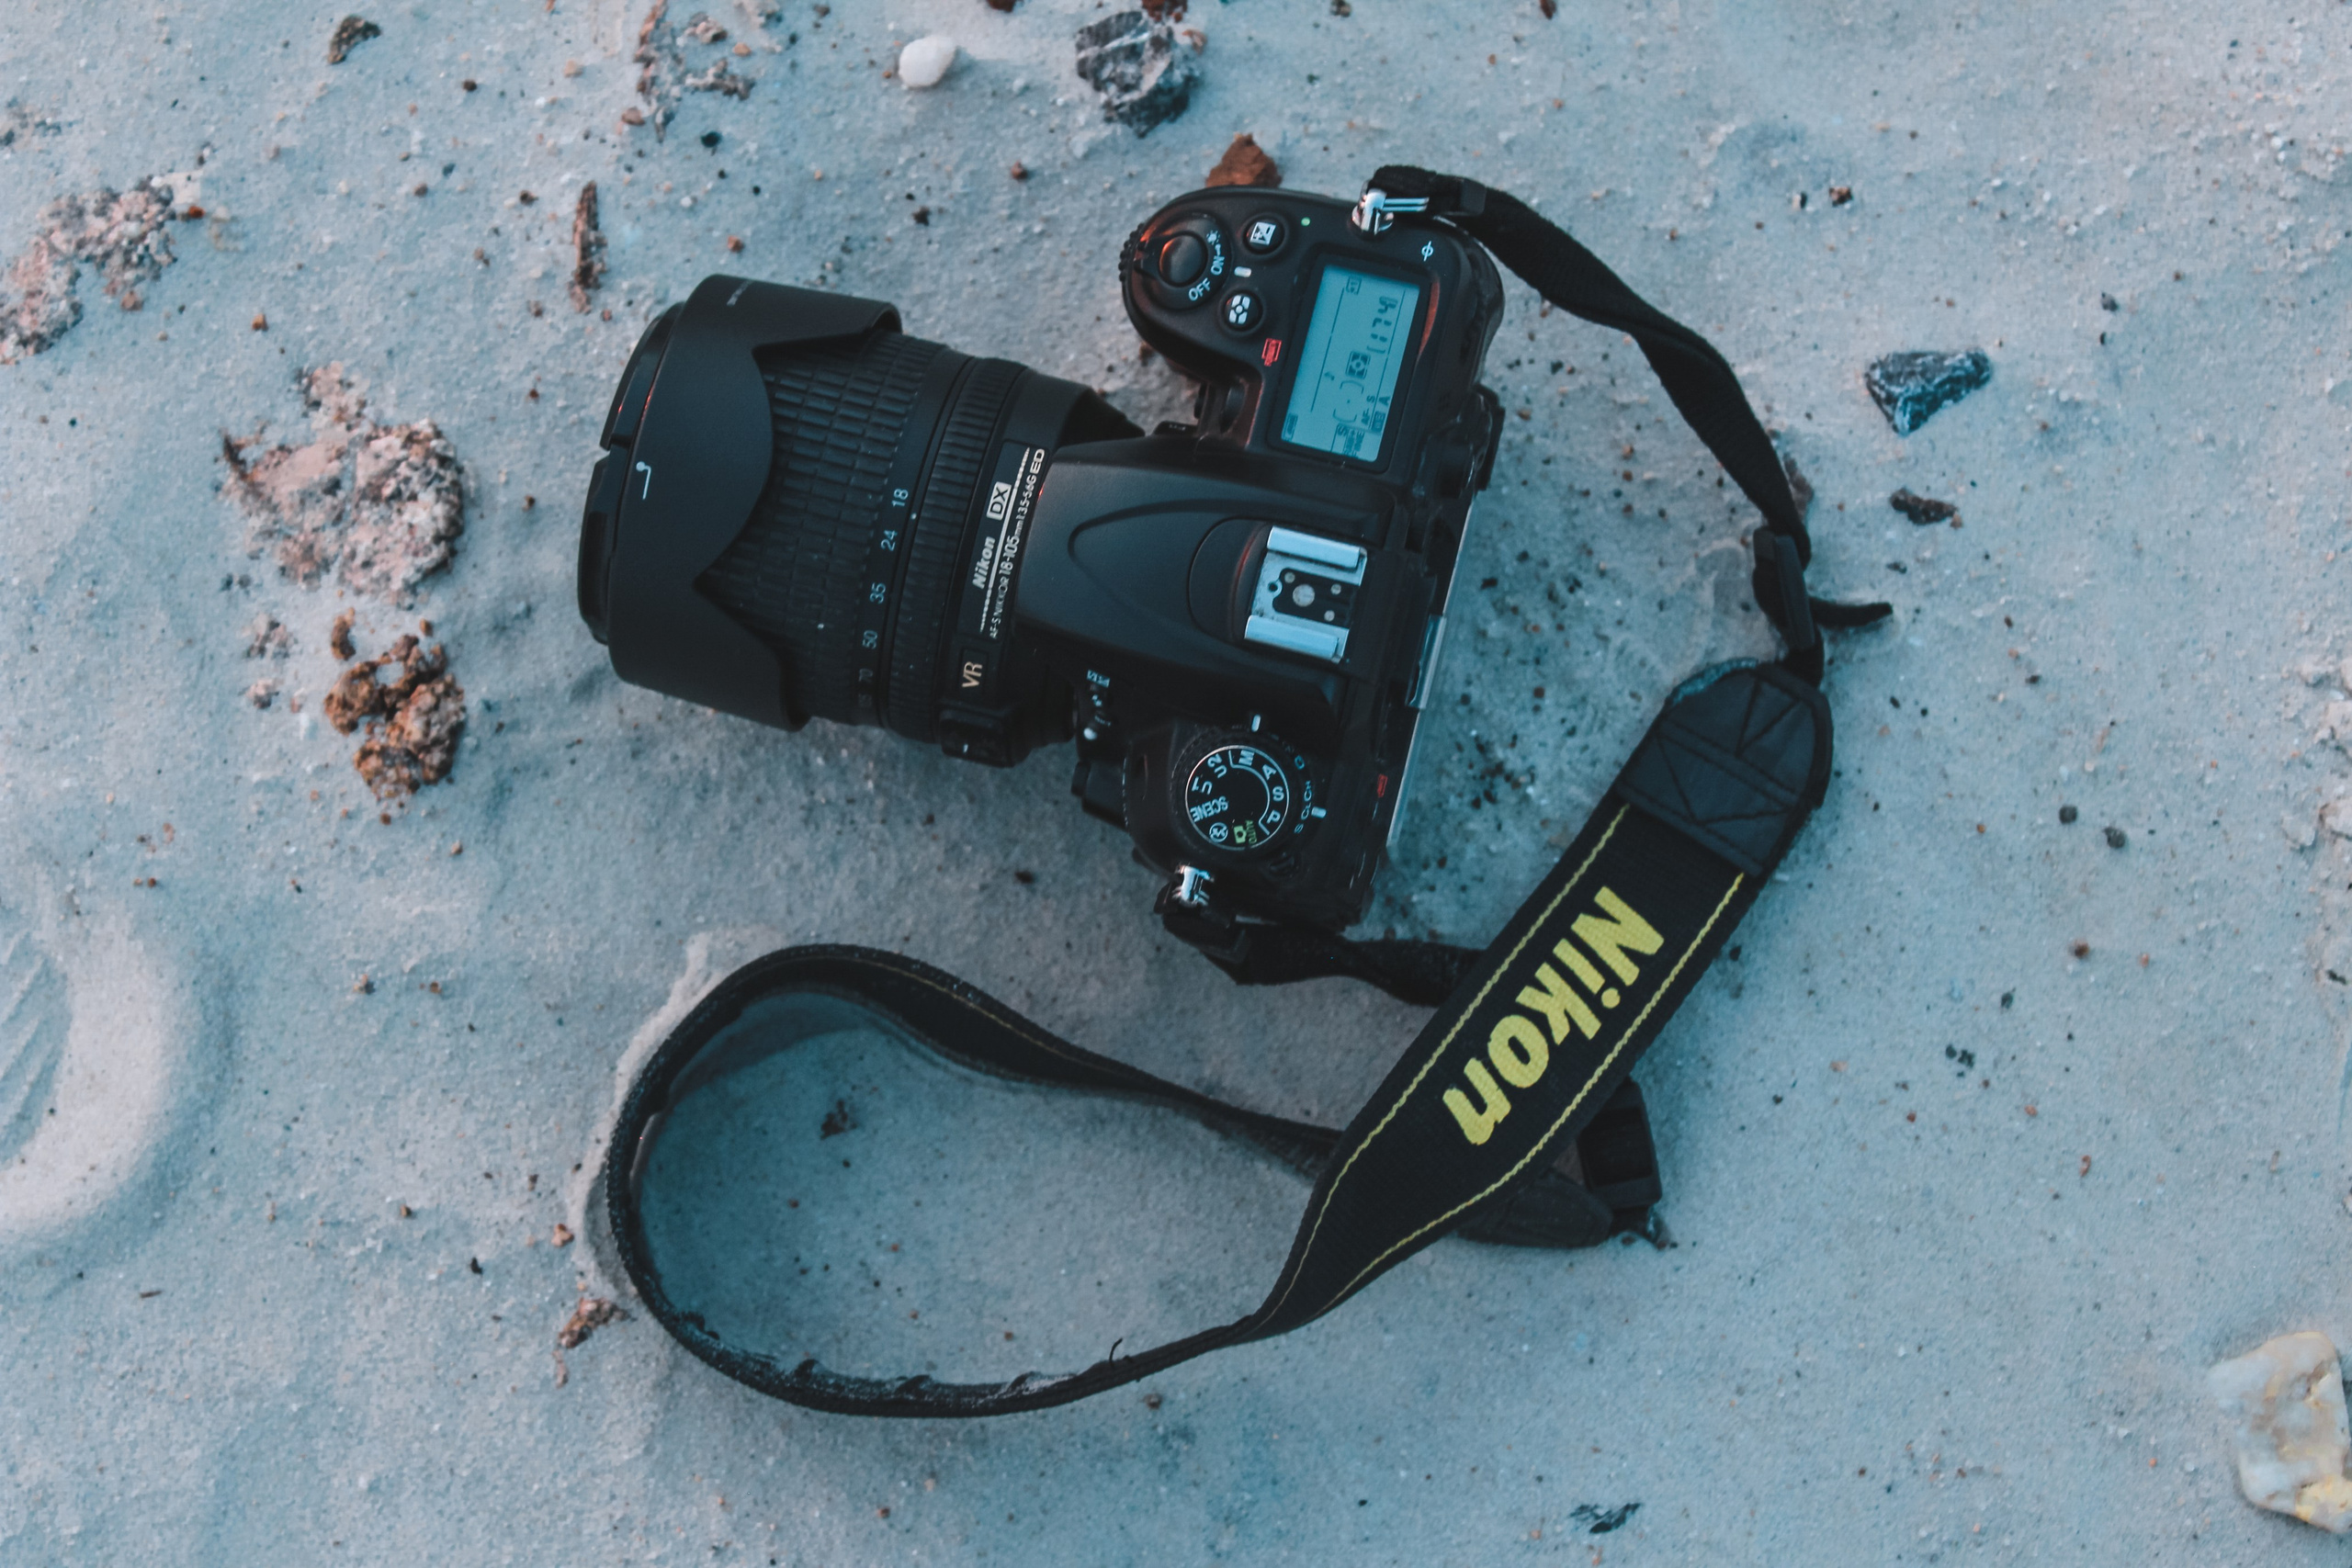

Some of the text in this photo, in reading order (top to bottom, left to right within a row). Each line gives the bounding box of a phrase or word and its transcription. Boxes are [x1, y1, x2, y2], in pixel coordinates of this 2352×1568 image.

[1210, 255, 1225, 276] ON
[1188, 277, 1211, 301] OFF
[1029, 448, 1046, 474] ED
[891, 488, 909, 507] 18
[989, 485, 1010, 517] DX
[880, 529, 898, 551] 24
[972, 536, 995, 589] Nikon
[869, 582, 887, 604] 35
[862, 630, 878, 649] 50
[961, 661, 983, 688] VR
[1206, 753, 1227, 778] U2
[1238, 749, 1255, 766] M
[1261, 763, 1277, 780] A
[1191, 776, 1213, 795] U1
[1272, 785, 1284, 802] S
[1190, 795, 1228, 823] SCENE
[1266, 809, 1281, 824] P
[1442, 886, 1665, 1146] Nikon
